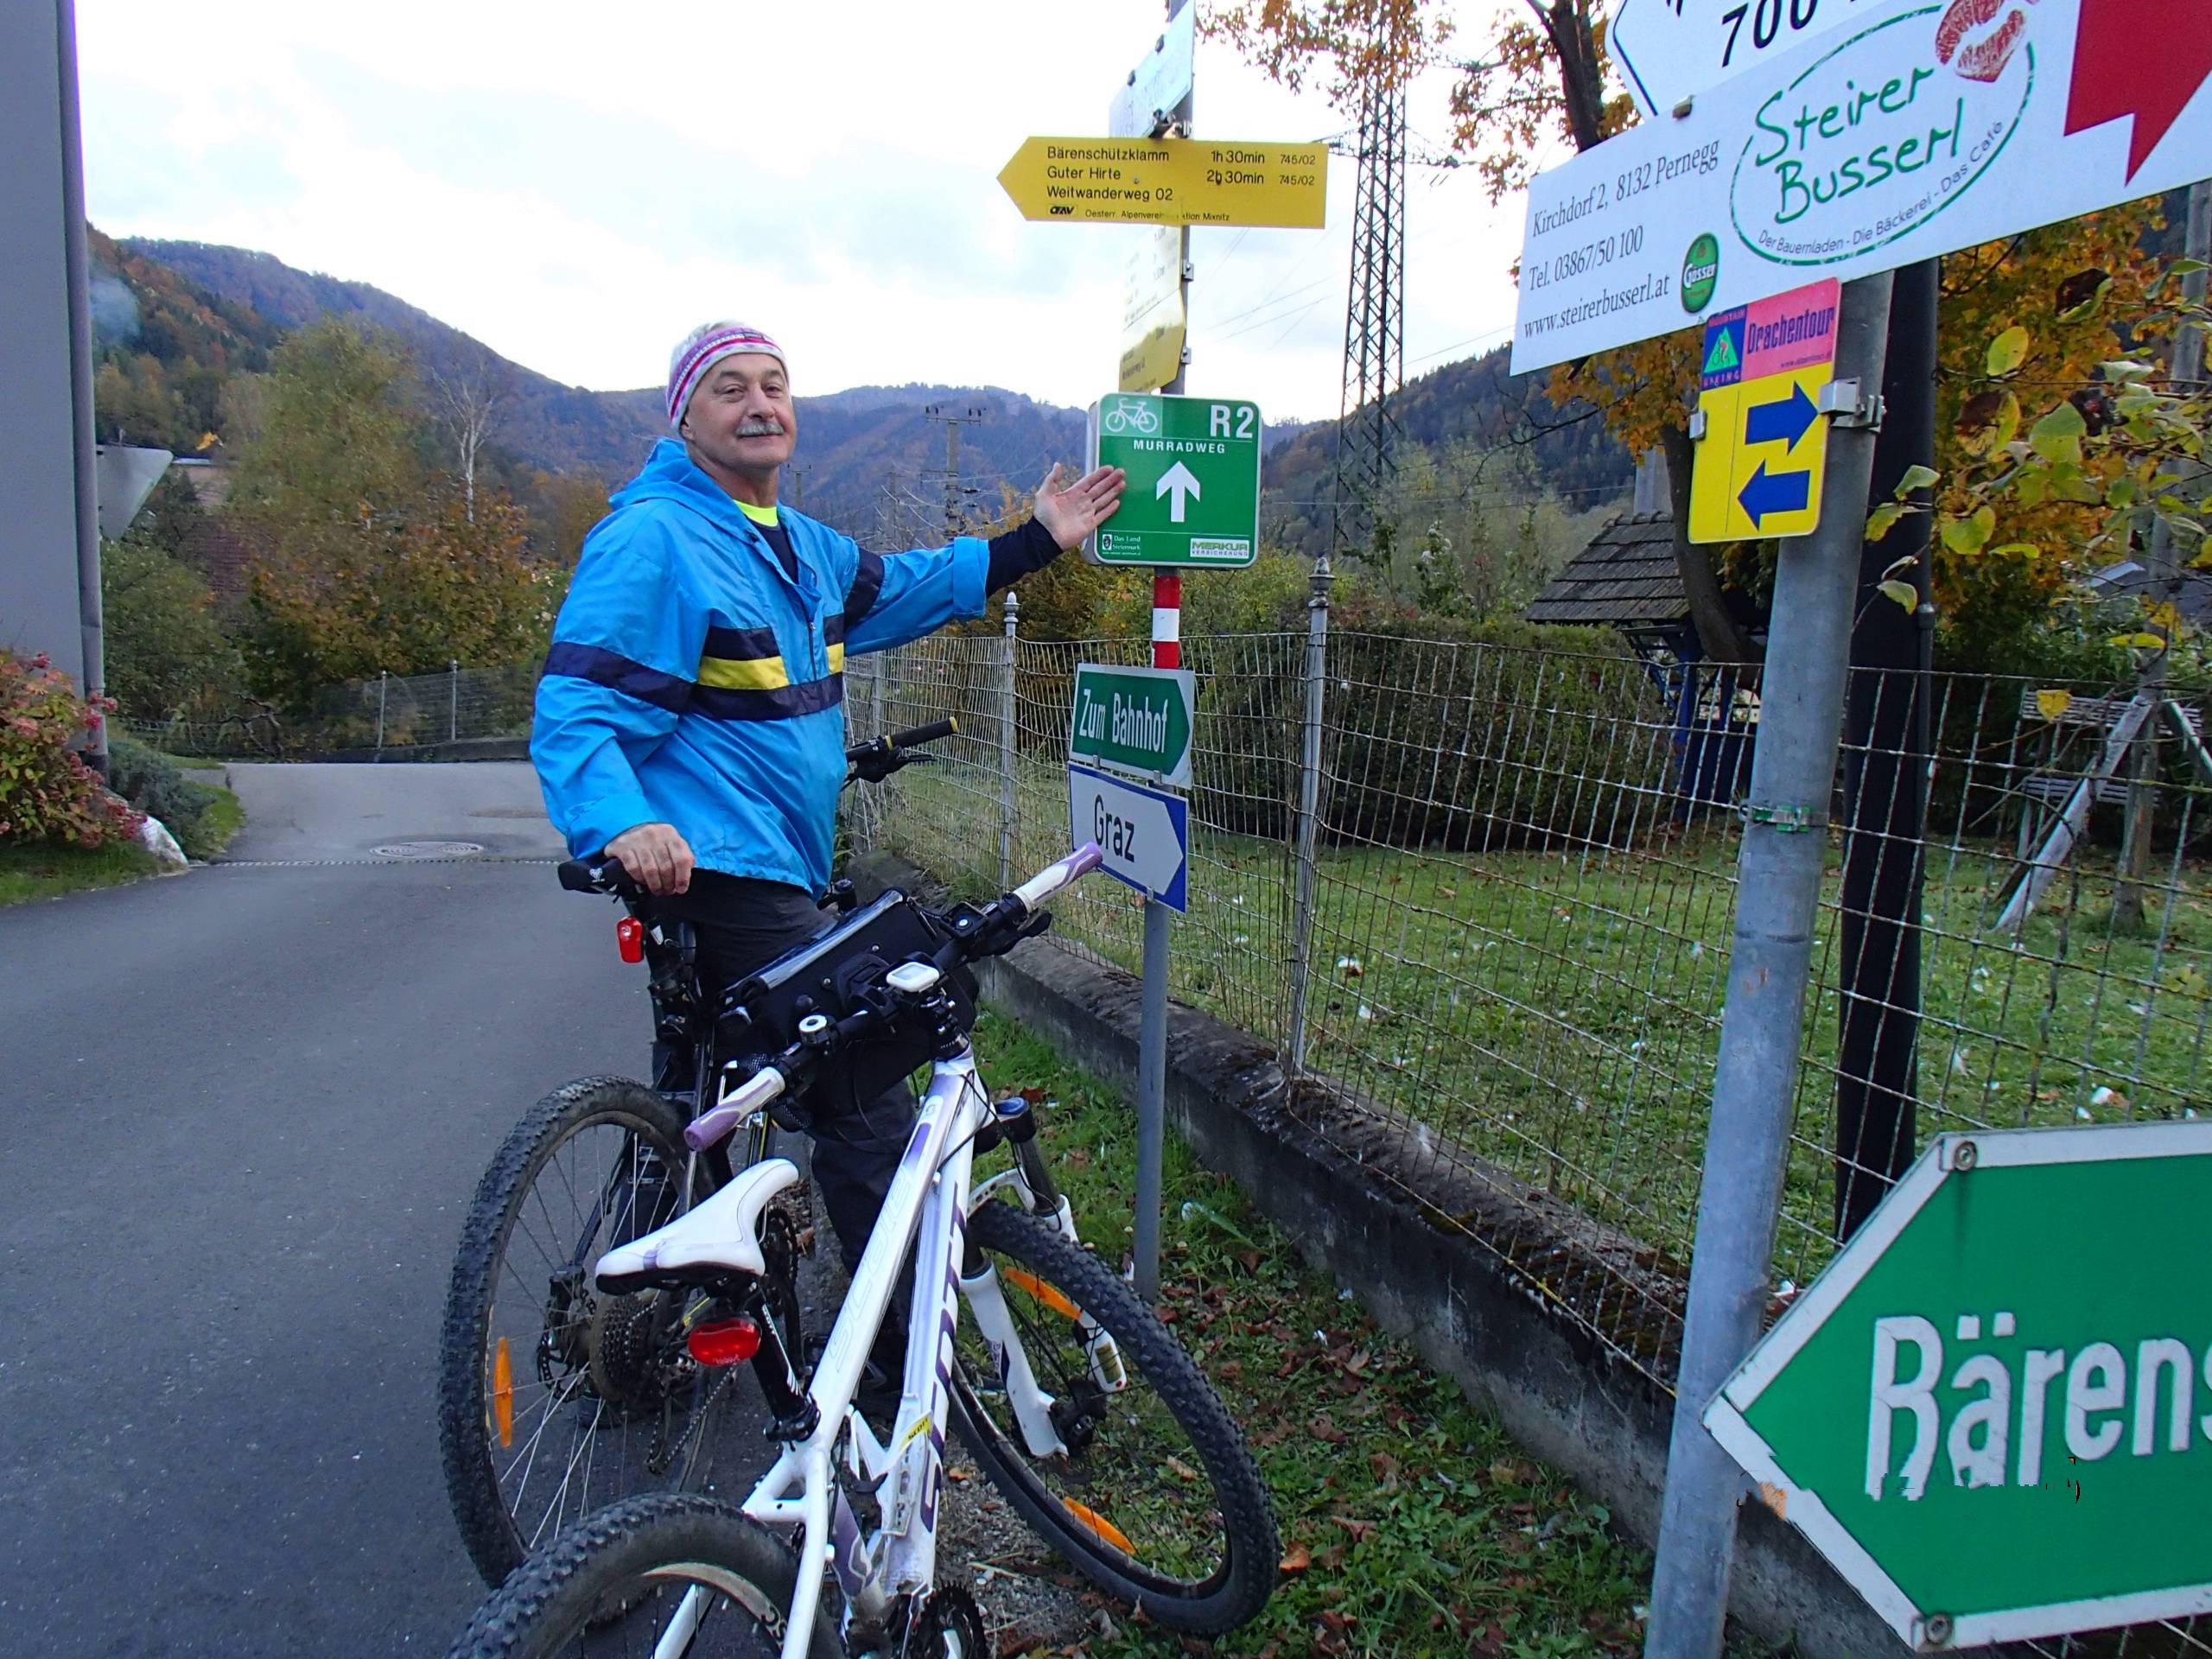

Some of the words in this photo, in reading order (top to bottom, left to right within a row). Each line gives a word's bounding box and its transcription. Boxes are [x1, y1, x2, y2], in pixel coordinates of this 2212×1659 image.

[1755, 67, 1936, 167] Steirer
[1047, 146, 1170, 162] Bärenschützklamm
[1047, 166, 1084, 179] Guter
[1089, 167, 1122, 180] Hirte
[1279, 175, 1315, 186] 745/02
[1775, 97, 1964, 224] Busserl
[1046, 186, 1150, 202] Weitwanderweg
[1155, 188, 1173, 200] 02
[1532, 186, 1597, 238] Kirchdorf
[1597, 183, 1608, 211] 2,
[1616, 162, 1651, 201] 8132
[1655, 140, 1719, 185] Pernegg
[1758, 229, 1777, 248] Der
[1777, 237, 1844, 254] Bauernladen
[1853, 227, 1873, 245] Die
[1876, 192, 1932, 236] Bäckerei
[1941, 164, 1967, 193] Das
[1529, 262, 1550, 291] Tel.
[1554, 237, 1614, 282] 03867/50
[1618, 226, 1643, 258] 100
[1524, 268, 1670, 338] www.steirerbusserl.at
[1746, 308, 1835, 355] Drachentour
[1134, 440, 1225, 454] MURRADWEG
[1079, 689, 1106, 741] Zum
[1112, 692, 1168, 753] Bahnhof
[1094, 794, 1135, 862] Graz
[1866, 1311, 2212, 1501] Bären
